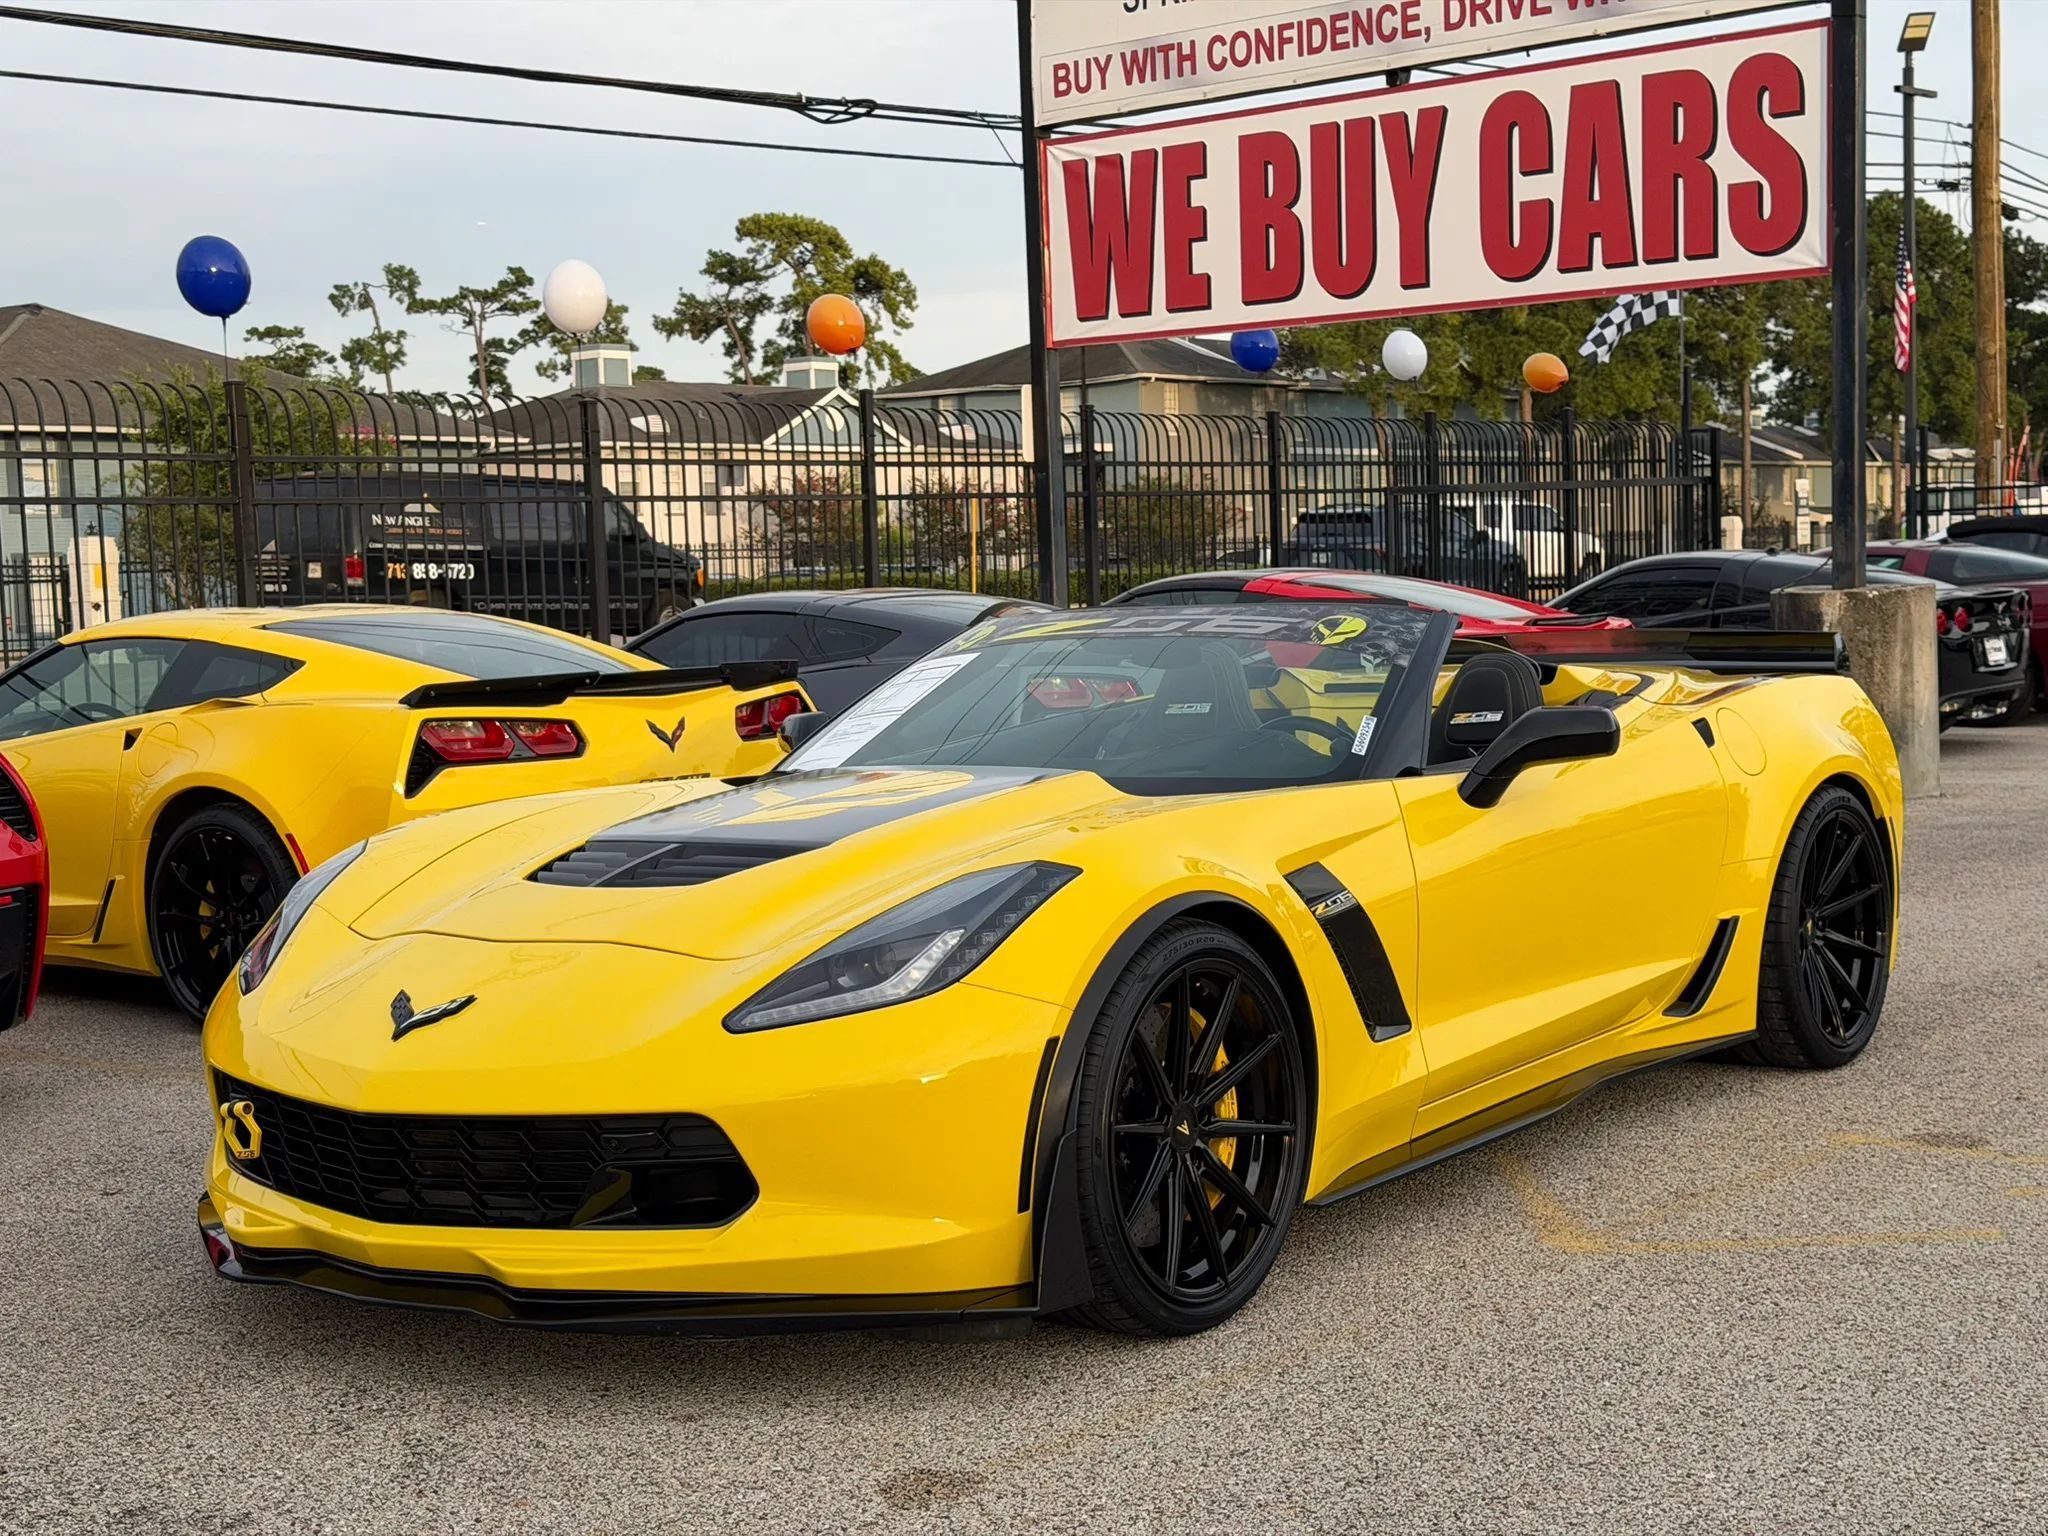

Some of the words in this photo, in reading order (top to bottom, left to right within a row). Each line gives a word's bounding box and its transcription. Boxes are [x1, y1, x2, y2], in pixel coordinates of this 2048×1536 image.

[1053, 55, 1113, 98] BUY
[1120, 40, 1197, 86] WITH
[1207, 0, 1431, 71] CONFIDENCE,
[1443, 0, 1552, 31] DRIVE
[1062, 141, 1212, 322] WE
[1238, 105, 1448, 305] BUY
[1479, 52, 1807, 283] CARS
